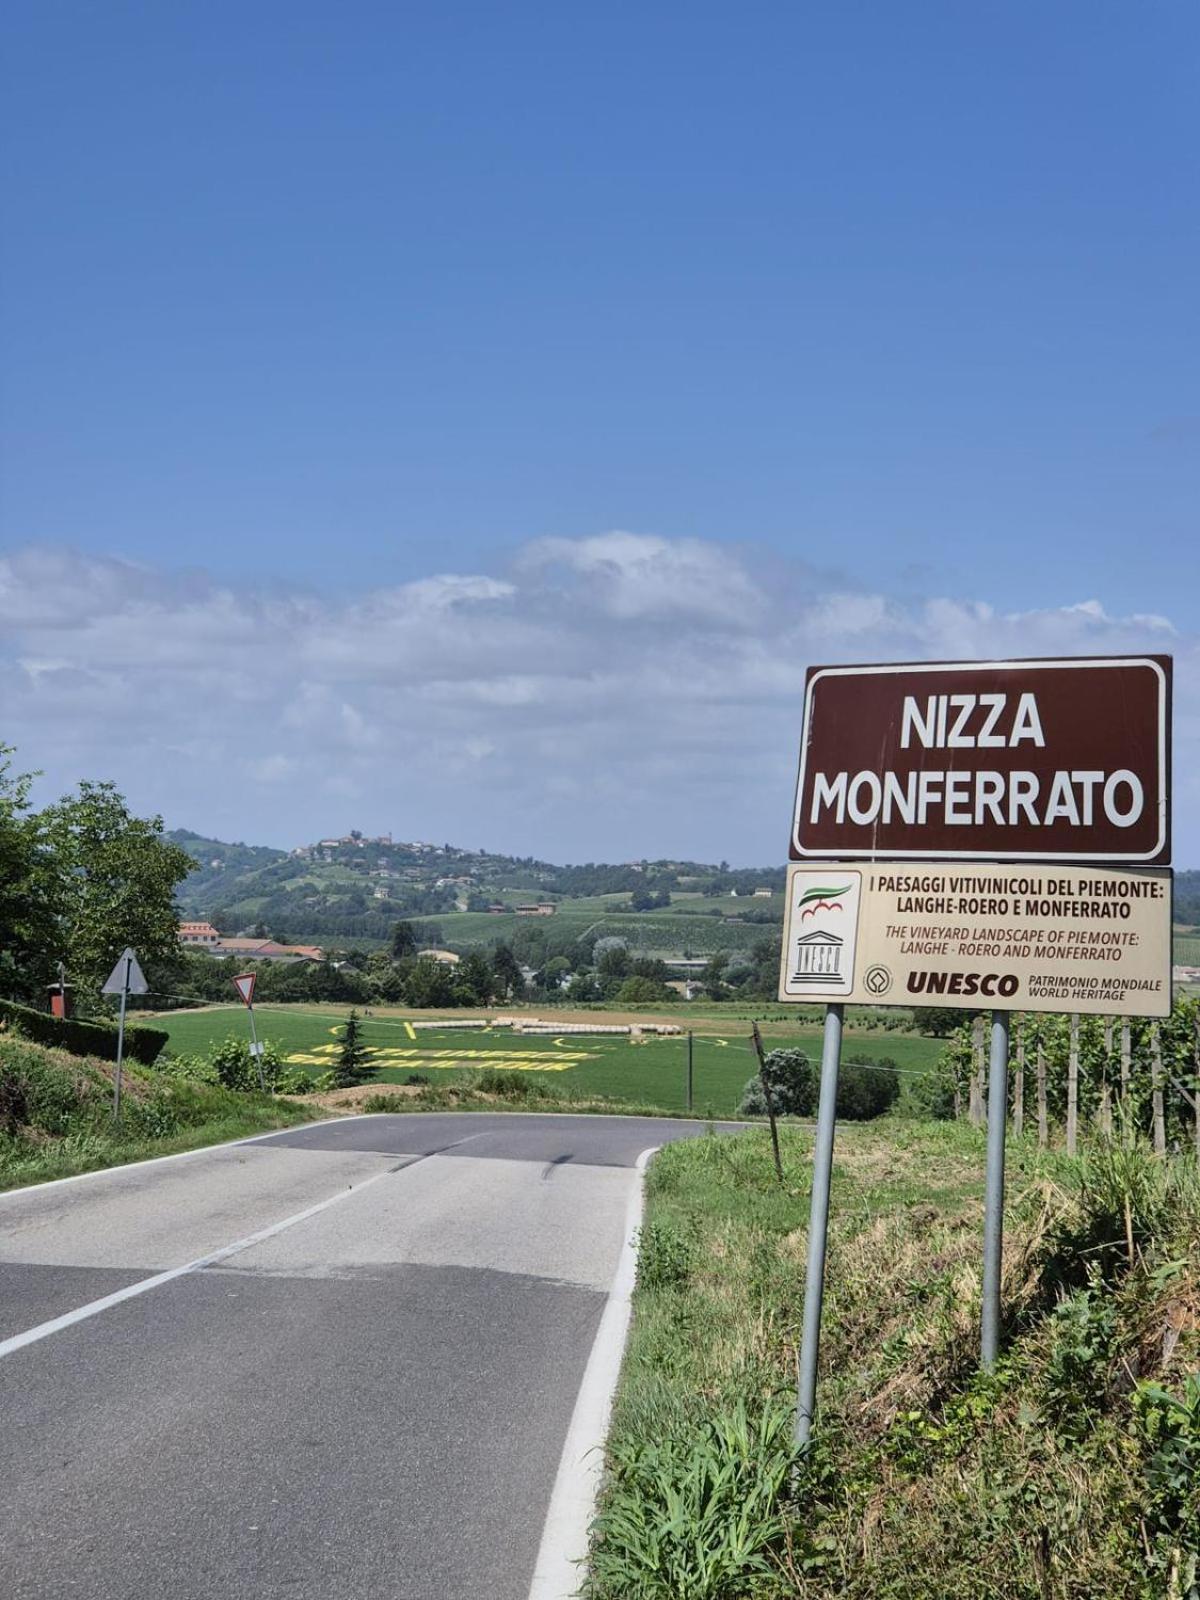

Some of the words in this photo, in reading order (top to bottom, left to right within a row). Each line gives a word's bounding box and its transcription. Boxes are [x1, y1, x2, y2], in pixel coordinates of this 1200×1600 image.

[900, 692, 1046, 749] NIZZA
[810, 769, 1144, 828] MONFERRATO
[869, 876, 875, 892] I
[878, 876, 945, 893] PAESAGGI
[949, 878, 1042, 895] VITIVINICOLI
[1047, 879, 1074, 896] DEL
[1078, 880, 1164, 899] PIEMONTE:
[897, 896, 1009, 915] LANGHE-ROERO
[1013, 899, 1021, 915] E
[1025, 900, 1131, 919] MONFERRATO
[885, 925, 908, 939] THE
[910, 926, 970, 940] VINEYARD
[972, 928, 1045, 943] LANDSCAPE
[1047, 930, 1065, 943] OF
[1067, 931, 1140, 946] PIEMONTE:
[900, 941, 949, 955] LANGHE
[958, 943, 1001, 957] ROERO
[1003, 945, 1031, 958] AND
[1033, 946, 1122, 961] MONFERRATO
[906, 971, 1019, 997] UNESCO
[1028, 975, 1099, 989] PATRIMONIO
[1101, 978, 1163, 992] MONDIALE
[1028, 987, 1069, 998] WORLD
[1072, 989, 1126, 1001] HERITAGE
